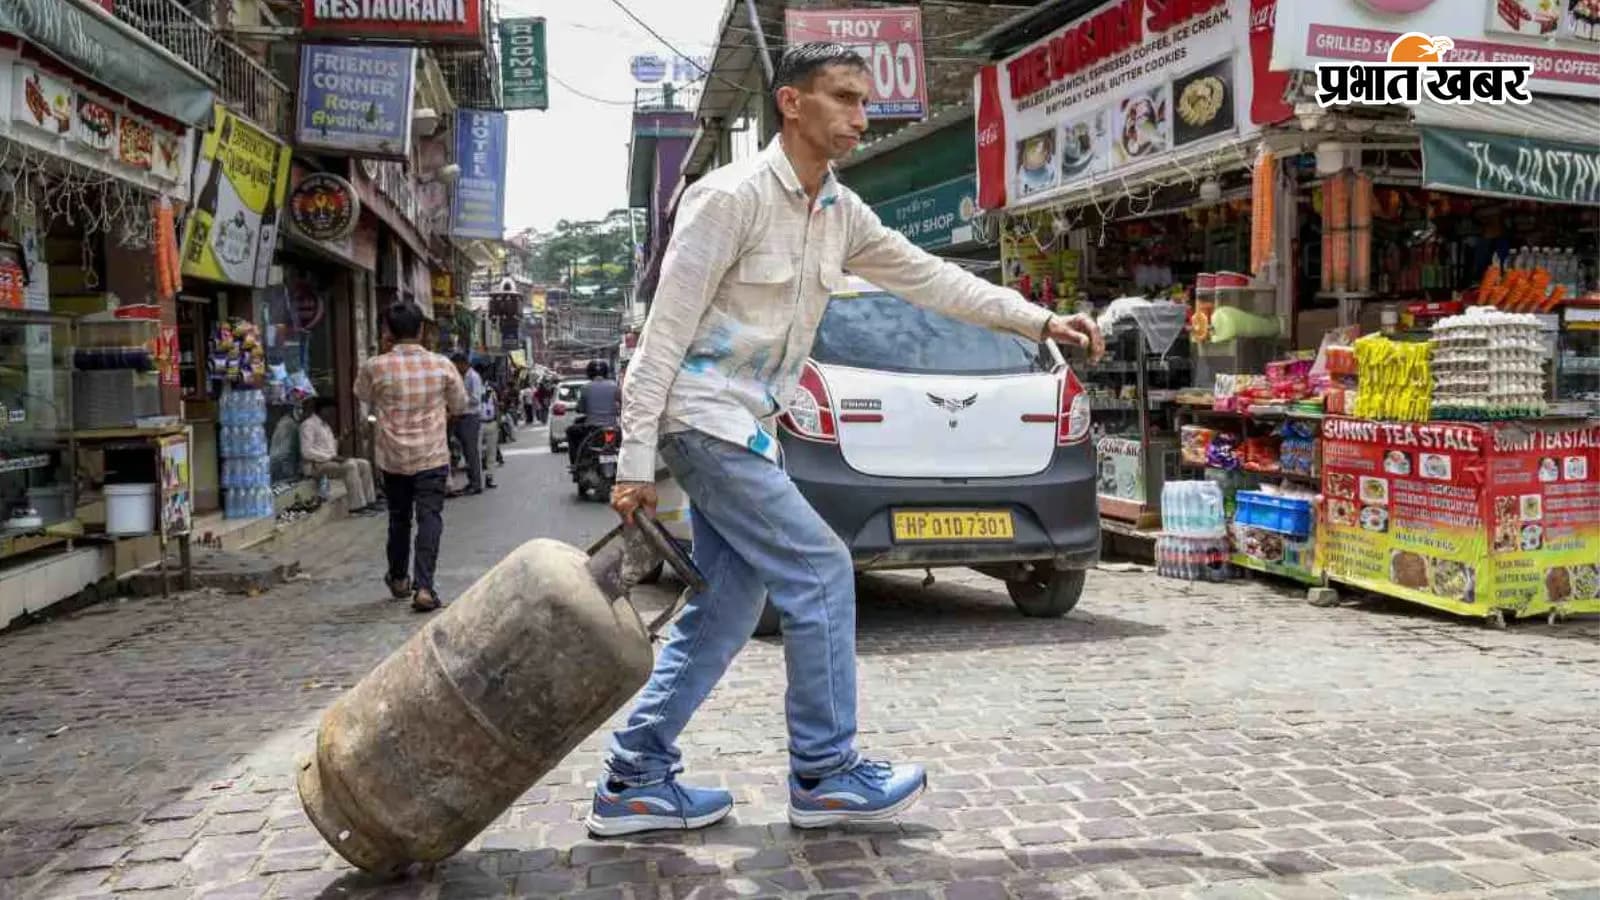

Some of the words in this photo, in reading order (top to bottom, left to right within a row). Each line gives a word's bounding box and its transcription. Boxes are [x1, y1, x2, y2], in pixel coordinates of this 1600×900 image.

[314, 0, 464, 20] RESTAURANT
[827, 20, 881, 37] TROY
[1173, 28, 1189, 43] ICE
[510, 24, 536, 78] ROOMS
[1317, 34, 1370, 53] GRILLED
[1373, 39, 1389, 54] SA
[313, 53, 399, 78] FRIENDS
[1110, 68, 1143, 89] BUTTER
[1145, 47, 1188, 73] COOKIES
[313, 73, 395, 97] CORNER
[472, 113, 488, 177] HOTEL
[923, 212, 955, 233] SHOP
[1324, 420, 1378, 443] SUNNY
[1382, 424, 1418, 447] TEA
[1419, 426, 1479, 452] STALL
[1564, 428, 1600, 449] STAL
[906, 516, 926, 536] HP
[966, 516, 1006, 536] 7301
